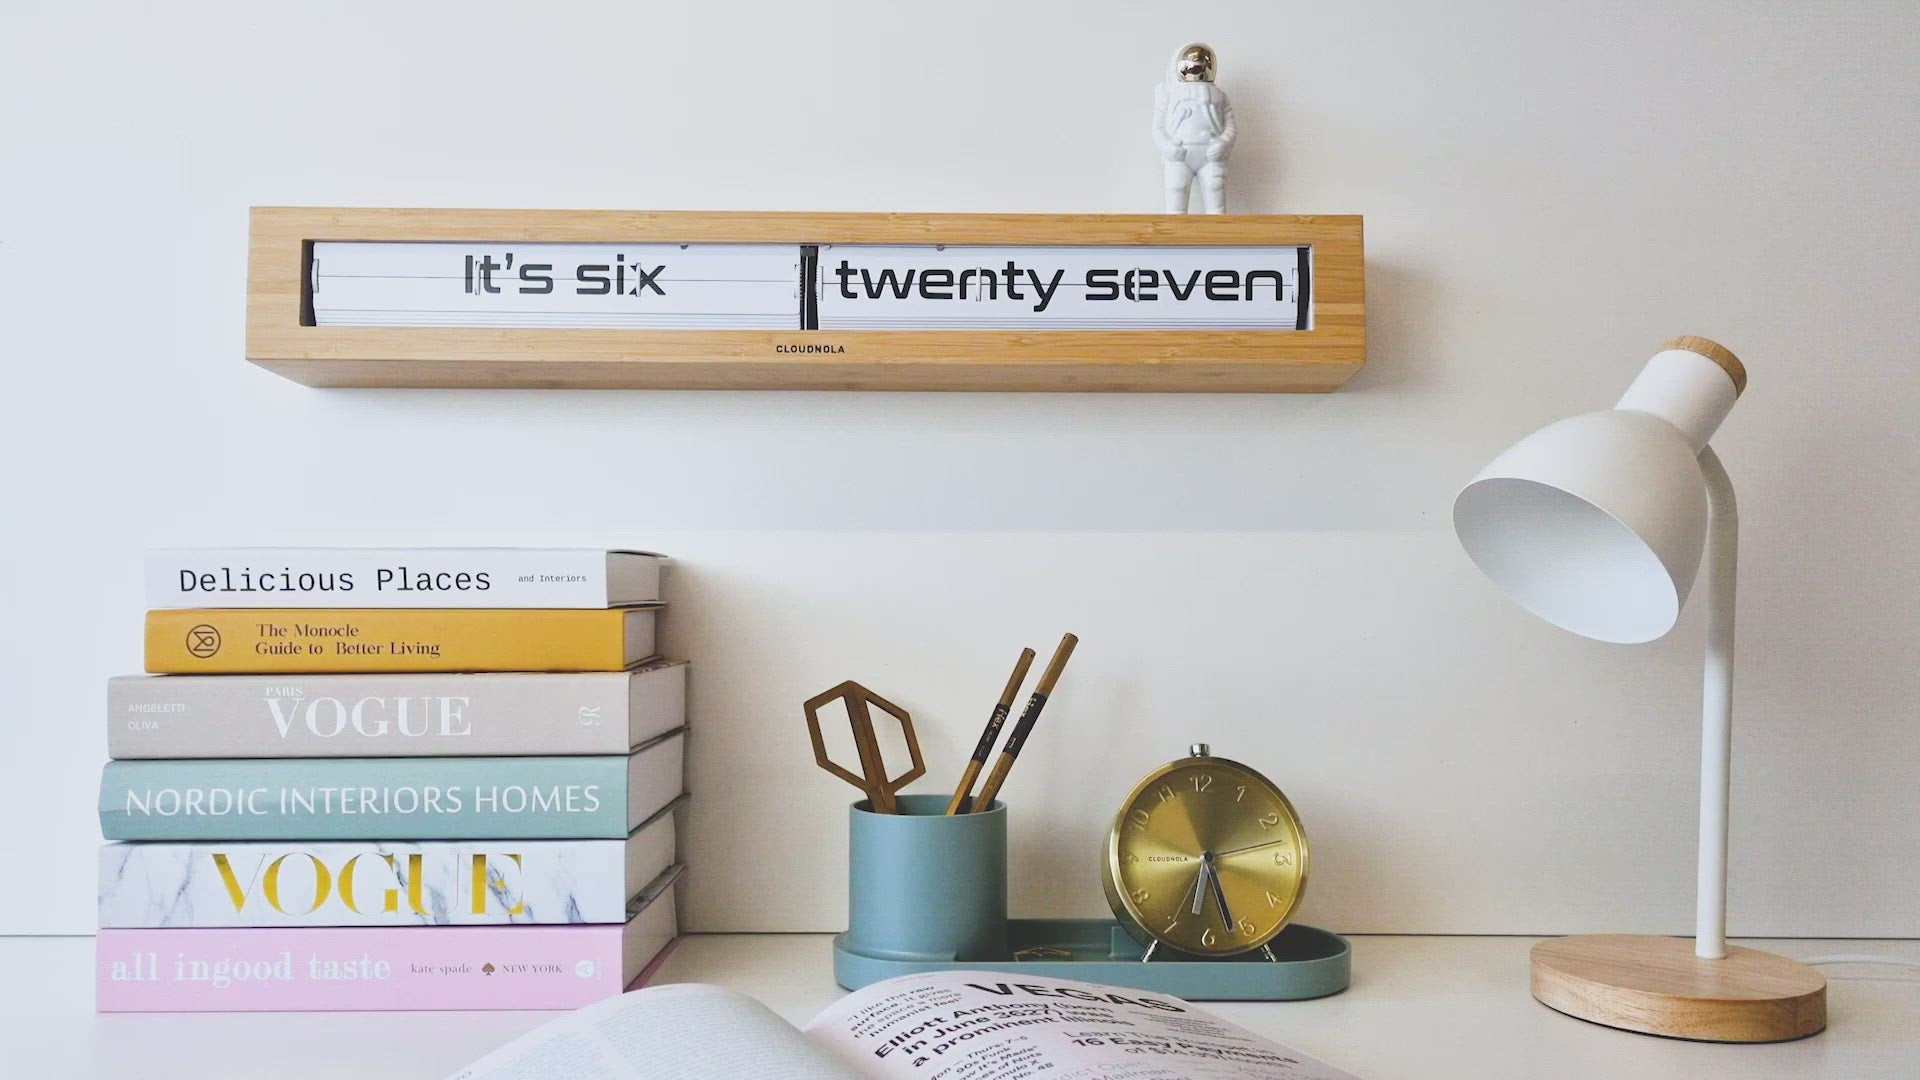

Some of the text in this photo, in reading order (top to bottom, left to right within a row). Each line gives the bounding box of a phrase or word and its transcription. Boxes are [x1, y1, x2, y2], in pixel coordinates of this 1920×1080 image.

[465, 253, 1283, 312] It's six twenty seven
[776, 345, 845, 354] CLOUDNOLA
[180, 565, 587, 594] Delicious Places and Interiors
[256, 623, 359, 637] The Monocle
[255, 641, 440, 658] Guide to Better Living
[266, 686, 302, 697] PARIS
[127, 703, 185, 713] ANGELETTI
[263, 696, 472, 739] VOGUE
[127, 721, 159, 730] OLIVA
[1190, 775, 1214, 793] 12
[126, 785, 601, 817] NORDIC INTERIORS HOMES
[1258, 812, 1279, 831] 2
[1274, 852, 1292, 867] 3
[211, 853, 524, 916] VOGUE
[1132, 889, 1149, 905] 8
[1238, 916, 1256, 937] 5
[1201, 928, 1216, 947] 6
[111, 953, 158, 981] all
[308, 953, 391, 980] taste
[411, 963, 562, 977] kate spade NEW YORK
[860, 1002, 883, 1015] like
[885, 992, 907, 1002] the
[910, 986, 935, 994] raw
[964, 983, 1186, 1012] VEGAS
[854, 1024, 875, 1039] the
[878, 1004, 914, 1023] space
[870, 1005, 932, 1037] humanist
[875, 1017, 949, 1059] Elliott
[953, 1003, 1050, 1019] Anthony
[902, 1039, 928, 1055] in
[933, 1016, 990, 1039] June
[912, 1056, 930, 1068] a
[932, 1017, 1060, 1055] prominent
[1071, 1038, 1105, 1046] 16
[1109, 1038, 1171, 1048] Easy
[956, 1047, 1011, 1073] 90s Funk
[1012, 1052, 1042, 1063] Nuts
